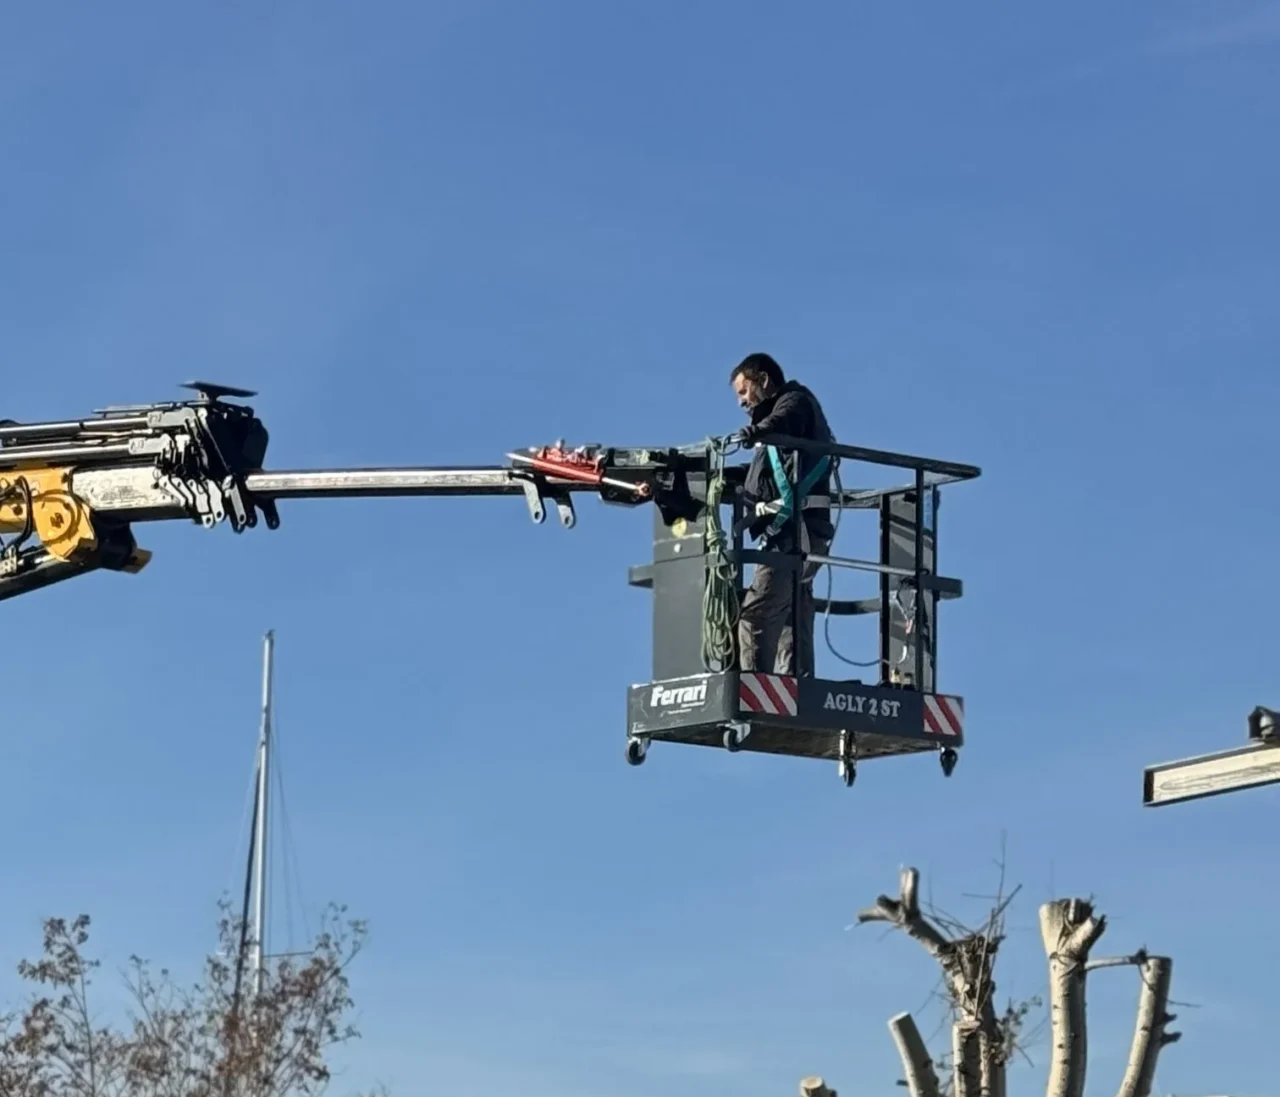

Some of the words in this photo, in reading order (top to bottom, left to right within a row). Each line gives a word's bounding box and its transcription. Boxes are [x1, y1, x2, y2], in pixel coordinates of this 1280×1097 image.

[650, 679, 708, 708] Ferrari
[823, 692, 866, 714] AGLY
[869, 695, 878, 717] 2
[879, 698, 901, 718] ST
